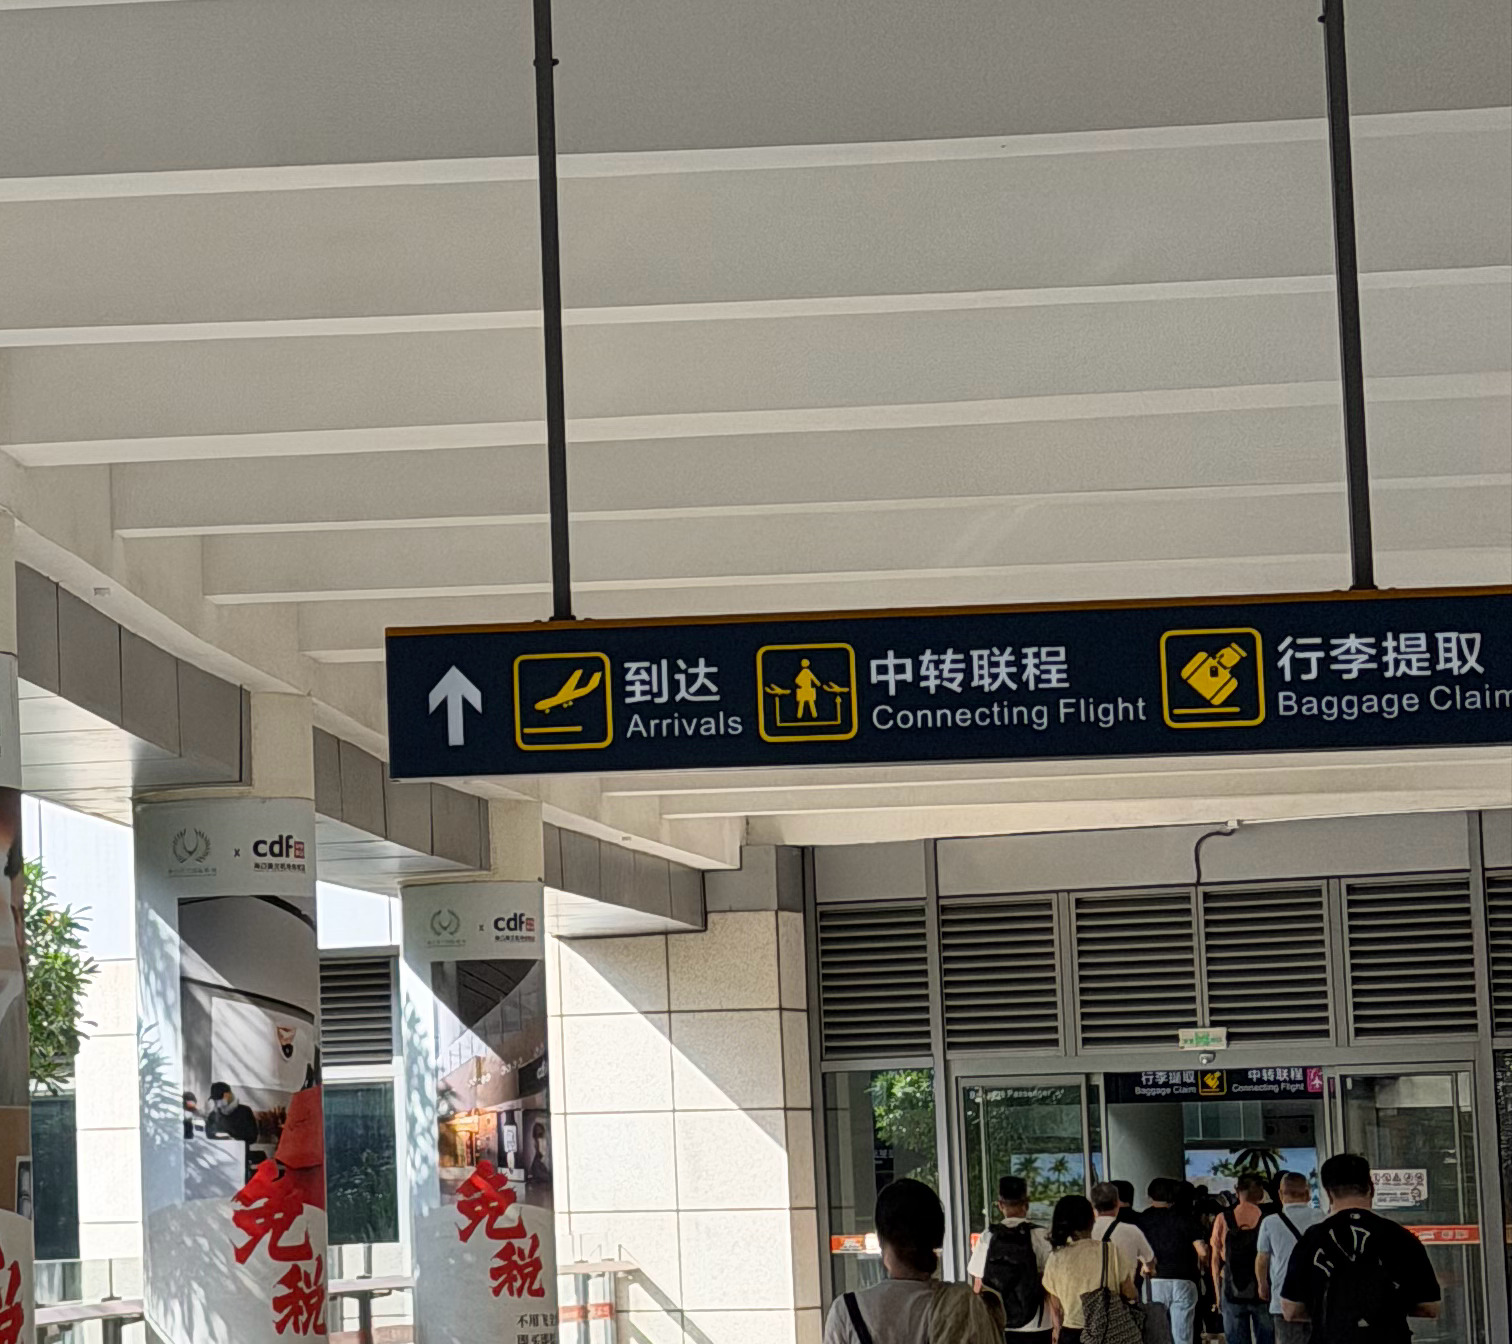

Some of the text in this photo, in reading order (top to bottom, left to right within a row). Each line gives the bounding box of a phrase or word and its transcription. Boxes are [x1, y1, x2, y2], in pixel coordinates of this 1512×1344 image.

[870, 645, 1071, 696] 中转联程
[1278, 631, 1485, 682] 行李提取
[623, 658, 721, 705] 到达
[872, 697, 1147, 731] Connecting Flight
[1278, 692, 1420, 721] Baggage
[626, 712, 744, 739] Arrivals
[253, 834, 293, 858] cdf
[493, 912, 525, 932] cdf
[1140, 1070, 1196, 1085] 行李提取
[1232, 1082, 1304, 1093] Connecting Flight
[1247, 1067, 1304, 1081] 中转联程
[1135, 1085, 1197, 1096] Baggage Claim
[454, 1160, 546, 1298] 免税
[230, 1158, 328, 1336] 免税
